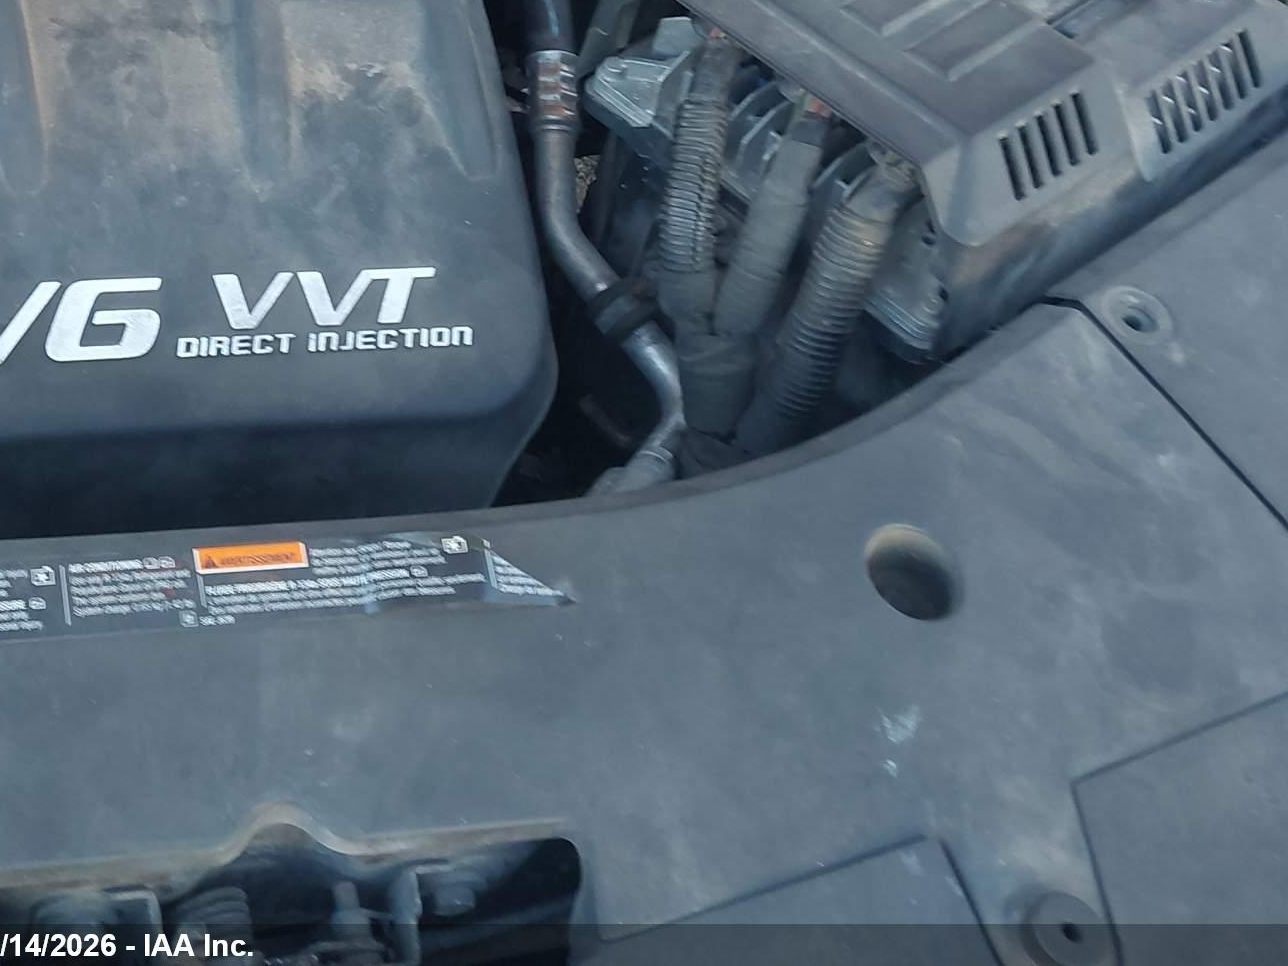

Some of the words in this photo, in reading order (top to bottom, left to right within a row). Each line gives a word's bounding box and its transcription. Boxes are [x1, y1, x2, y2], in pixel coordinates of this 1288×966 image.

[213, 267, 436, 330] VVT
[176, 333, 296, 358] DIRECT
[307, 325, 473, 352] INJECTION
